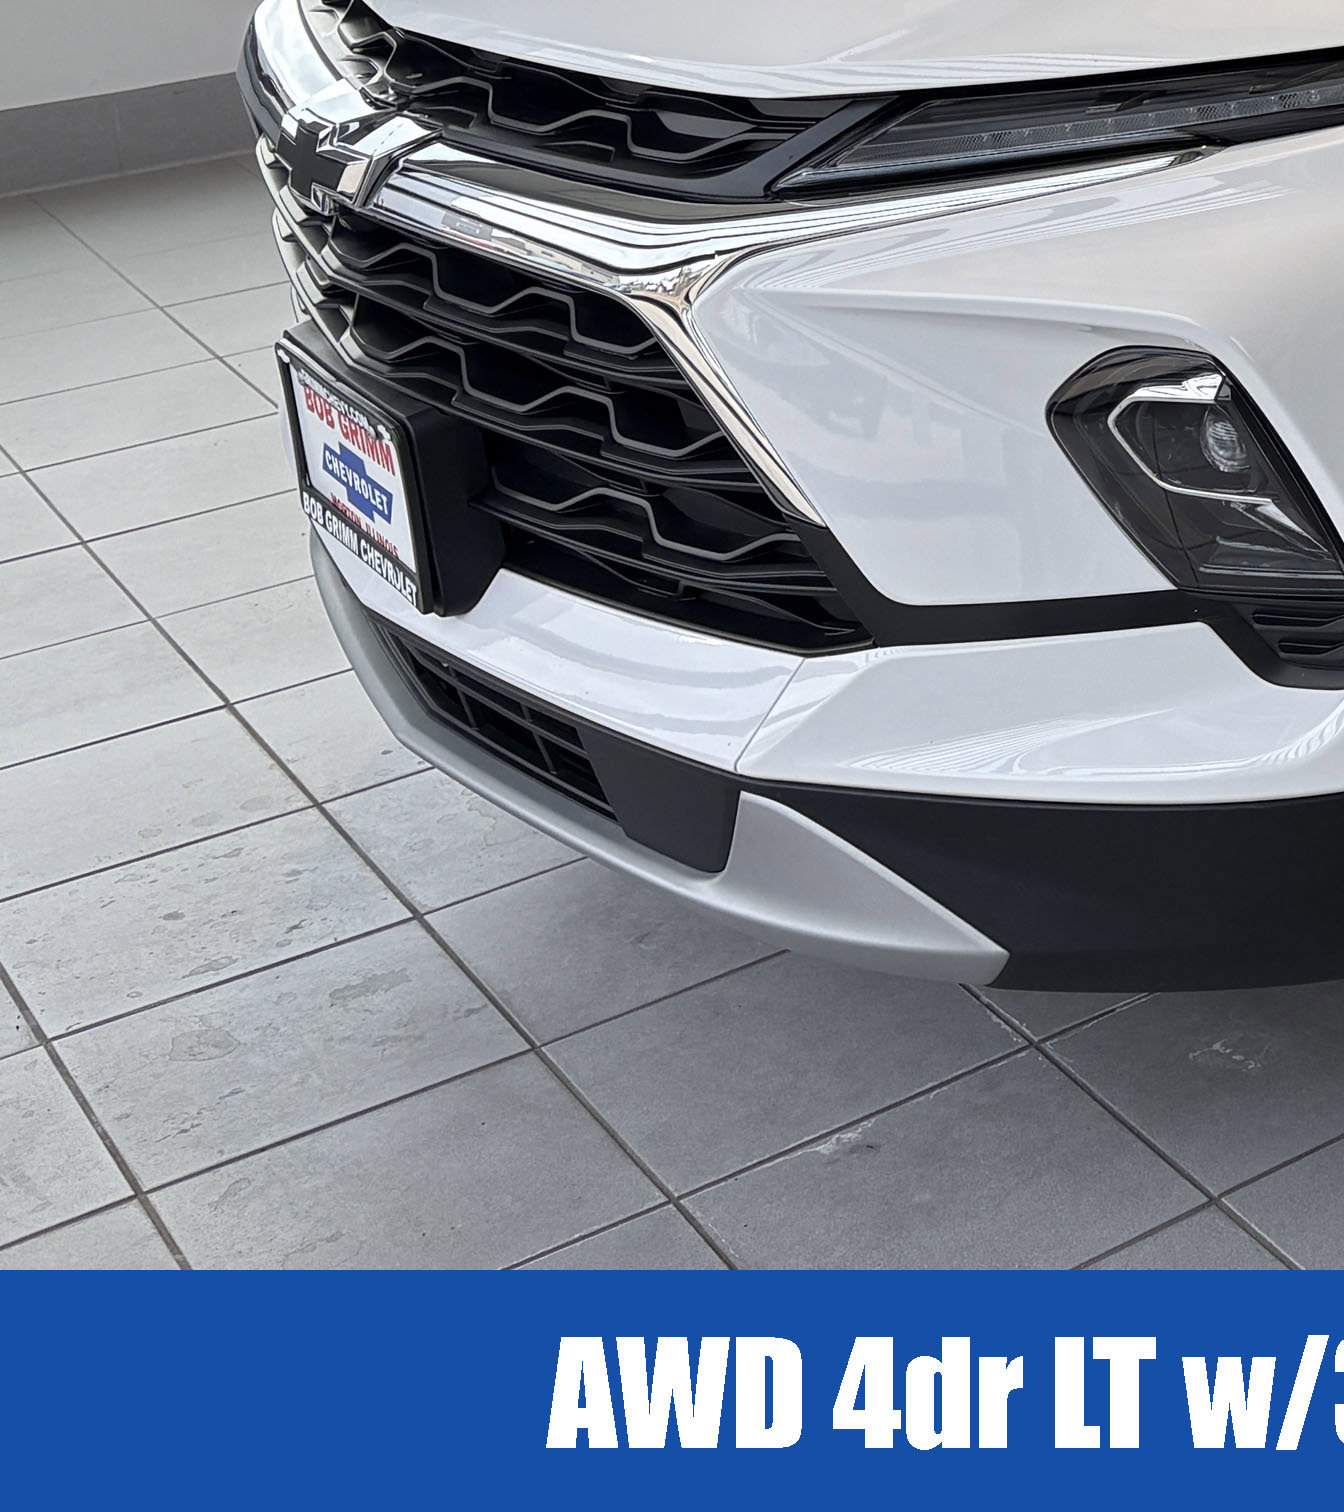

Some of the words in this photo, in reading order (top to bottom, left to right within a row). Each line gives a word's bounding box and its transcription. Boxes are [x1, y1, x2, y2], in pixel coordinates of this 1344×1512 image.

[303, 385, 335, 430] BOB
[337, 409, 396, 477] GRIMM
[324, 449, 389, 516] CHEVROLET
[303, 491, 324, 526] BOB
[325, 509, 360, 555] GRIMM
[361, 538, 417, 608] CHEVROLET
